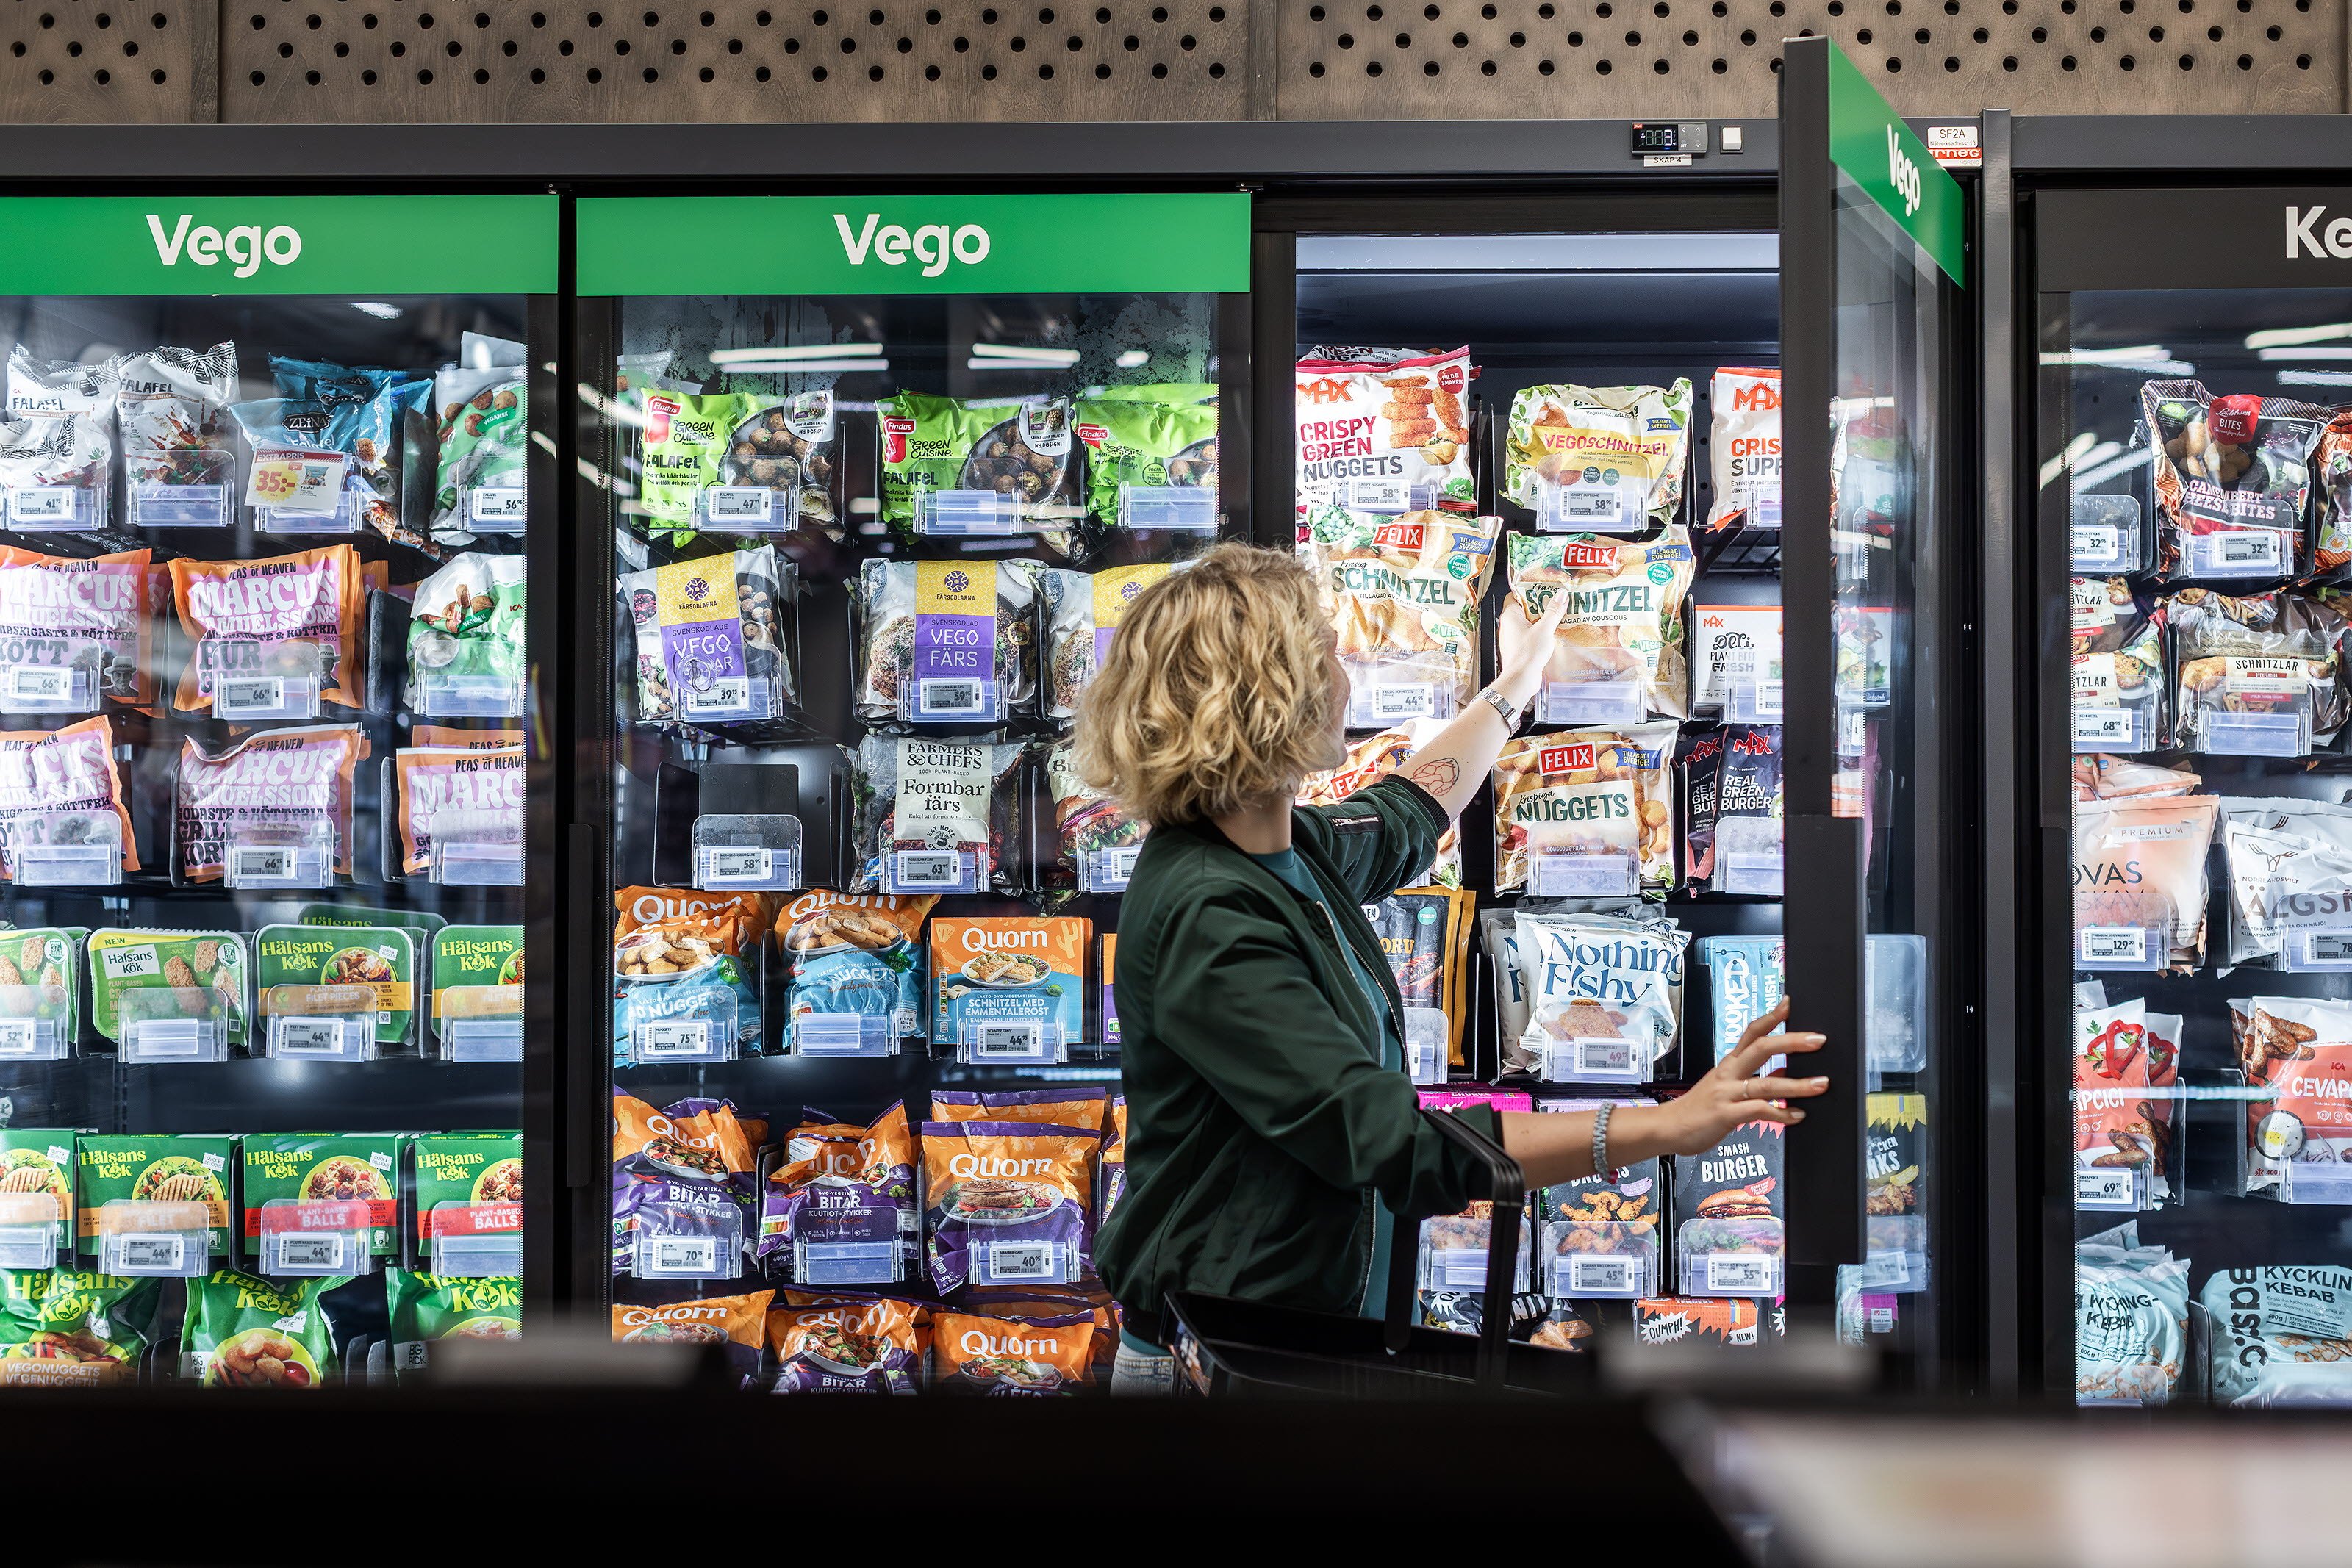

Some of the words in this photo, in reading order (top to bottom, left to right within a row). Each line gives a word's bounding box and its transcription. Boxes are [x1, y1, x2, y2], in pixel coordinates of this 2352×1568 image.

[1940, 129, 1965, 138] SF2A
[1887, 123, 1921, 217] Vego
[146, 214, 302, 278] Vego
[833, 213, 990, 277] Vego
[120, 378, 174, 392] FALAFEL
[1298, 377, 1353, 406] MAX
[12, 398, 66, 411] FALAFEL
[653, 402, 678, 414] Findus
[483, 411, 509, 426] VEGANSK
[2220, 417, 2242, 431] BITES
[673, 420, 715, 433] GREEN
[888, 422, 913, 431] Findus
[1081, 428, 1106, 439] Findus
[1300, 416, 1376, 442] CRISPY
[912, 438, 951, 452] GREEN
[1303, 437, 1372, 462] GREEN
[1544, 433, 1668, 456] VEGOSCHNITZEL
[257, 452, 304, 462] EXTRAPRIS
[911, 447, 953, 458] CUISINE
[646, 454, 701, 470] FALAFEL
[1304, 455, 1403, 483] NUGGETS
[883, 471, 939, 486] FALAFEL
[2188, 479, 2263, 504] CAMEMBERT
[2229, 502, 2276, 520] BITES
[1377, 527, 1420, 546] FELIX
[1568, 547, 1613, 564] FELIX
[65, 560, 98, 574] HEAVEN
[229, 564, 248, 580] PEAS
[251, 567, 259, 577] OF
[262, 561, 297, 575] HEAVEN
[1331, 567, 1455, 605] SCHNITZEL
[189, 569, 335, 619] MARCUS
[936, 593, 976, 602] FÄRSODLARNA
[931, 619, 979, 627] SVENSKODLAD
[1703, 615, 1724, 627] MAX
[672, 622, 728, 637] SVENSKODLADE
[930, 629, 980, 646] VEGO
[930, 650, 978, 668] FÄRS
[1710, 651, 1735, 661] PLANT
[2236, 659, 2298, 673] SCHNITZLAR
[4, 741, 23, 751] PEAS
[254, 741, 263, 751] OF
[267, 737, 304, 752] HEAVEN
[1732, 730, 1774, 755] MAX
[907, 743, 983, 758] FARMERS
[1622, 750, 1646, 758] TILLAGAT
[1685, 737, 1722, 766] MAX
[182, 747, 340, 785] MARCUS
[455, 760, 478, 772] PEAS
[483, 760, 492, 771] OF
[927, 755, 983, 770] CHEFS
[1544, 747, 1589, 770] FELIX
[1623, 757, 1650, 766] SVERIGE!
[1724, 774, 1759, 785] REAL
[179, 783, 338, 807] SAMUELSSONS
[903, 778, 986, 797] Formbar
[1721, 786, 1765, 798] GREEN
[924, 794, 961, 813] färs
[1519, 790, 1555, 805] Krispiga
[1720, 796, 1772, 810] BURGER
[1516, 793, 1629, 821] NUGGETS
[2121, 827, 2184, 837] PREMIUM
[2242, 877, 2299, 885] NORRLANDSVILT
[632, 893, 742, 925] Quorn
[105, 938, 126, 946] NEW
[961, 927, 1049, 954] Quorn
[261, 940, 334, 957] Hälsans
[441, 939, 513, 958] Hälsans
[108, 949, 153, 965] Hälsans
[1550, 932, 1683, 987] Nothing
[123, 960, 143, 974] Kök
[828, 968, 896, 986] NUGGETS
[968, 999, 1021, 1008] SCHNITZEL
[1023, 999, 1044, 1007] MED
[965, 1006, 1050, 1017] EMMENTALEROST
[934, 1033, 948, 1041] 220g
[2331, 1062, 2345, 1071] ICA
[1718, 1141, 1750, 1157] SMASH
[81, 1149, 146, 1166] Hälsans
[246, 1150, 313, 1166] Hälsans
[417, 1152, 484, 1170] Hälsans
[949, 1154, 1053, 1181] Quorn
[1701, 1154, 1769, 1184] BURGER
[667, 1185, 721, 1209] BITAR
[820, 1195, 861, 1209] BITAR
[298, 1206, 348, 1217] PLANT-BASED
[694, 1207, 732, 1220] STYKKER
[808, 1209, 839, 1218] KUUTIOT
[842, 1209, 872, 1218] STYKKER
[301, 1214, 345, 1228] BALLS
[474, 1216, 518, 1230] BALLS
[7, 1272, 137, 1300] Hälsans
[2265, 1282, 2336, 1304] KEBAB
[622, 1306, 728, 1327] Quorn
[1649, 1318, 1683, 1340] OUMPH!
[1736, 1331, 1754, 1342] NEW!
[960, 1330, 1058, 1359] Quorn
[192, 1355, 204, 1367] BIG
[7, 1362, 101, 1378] VEGONUGGETS
[193, 1365, 207, 1377] PACK
